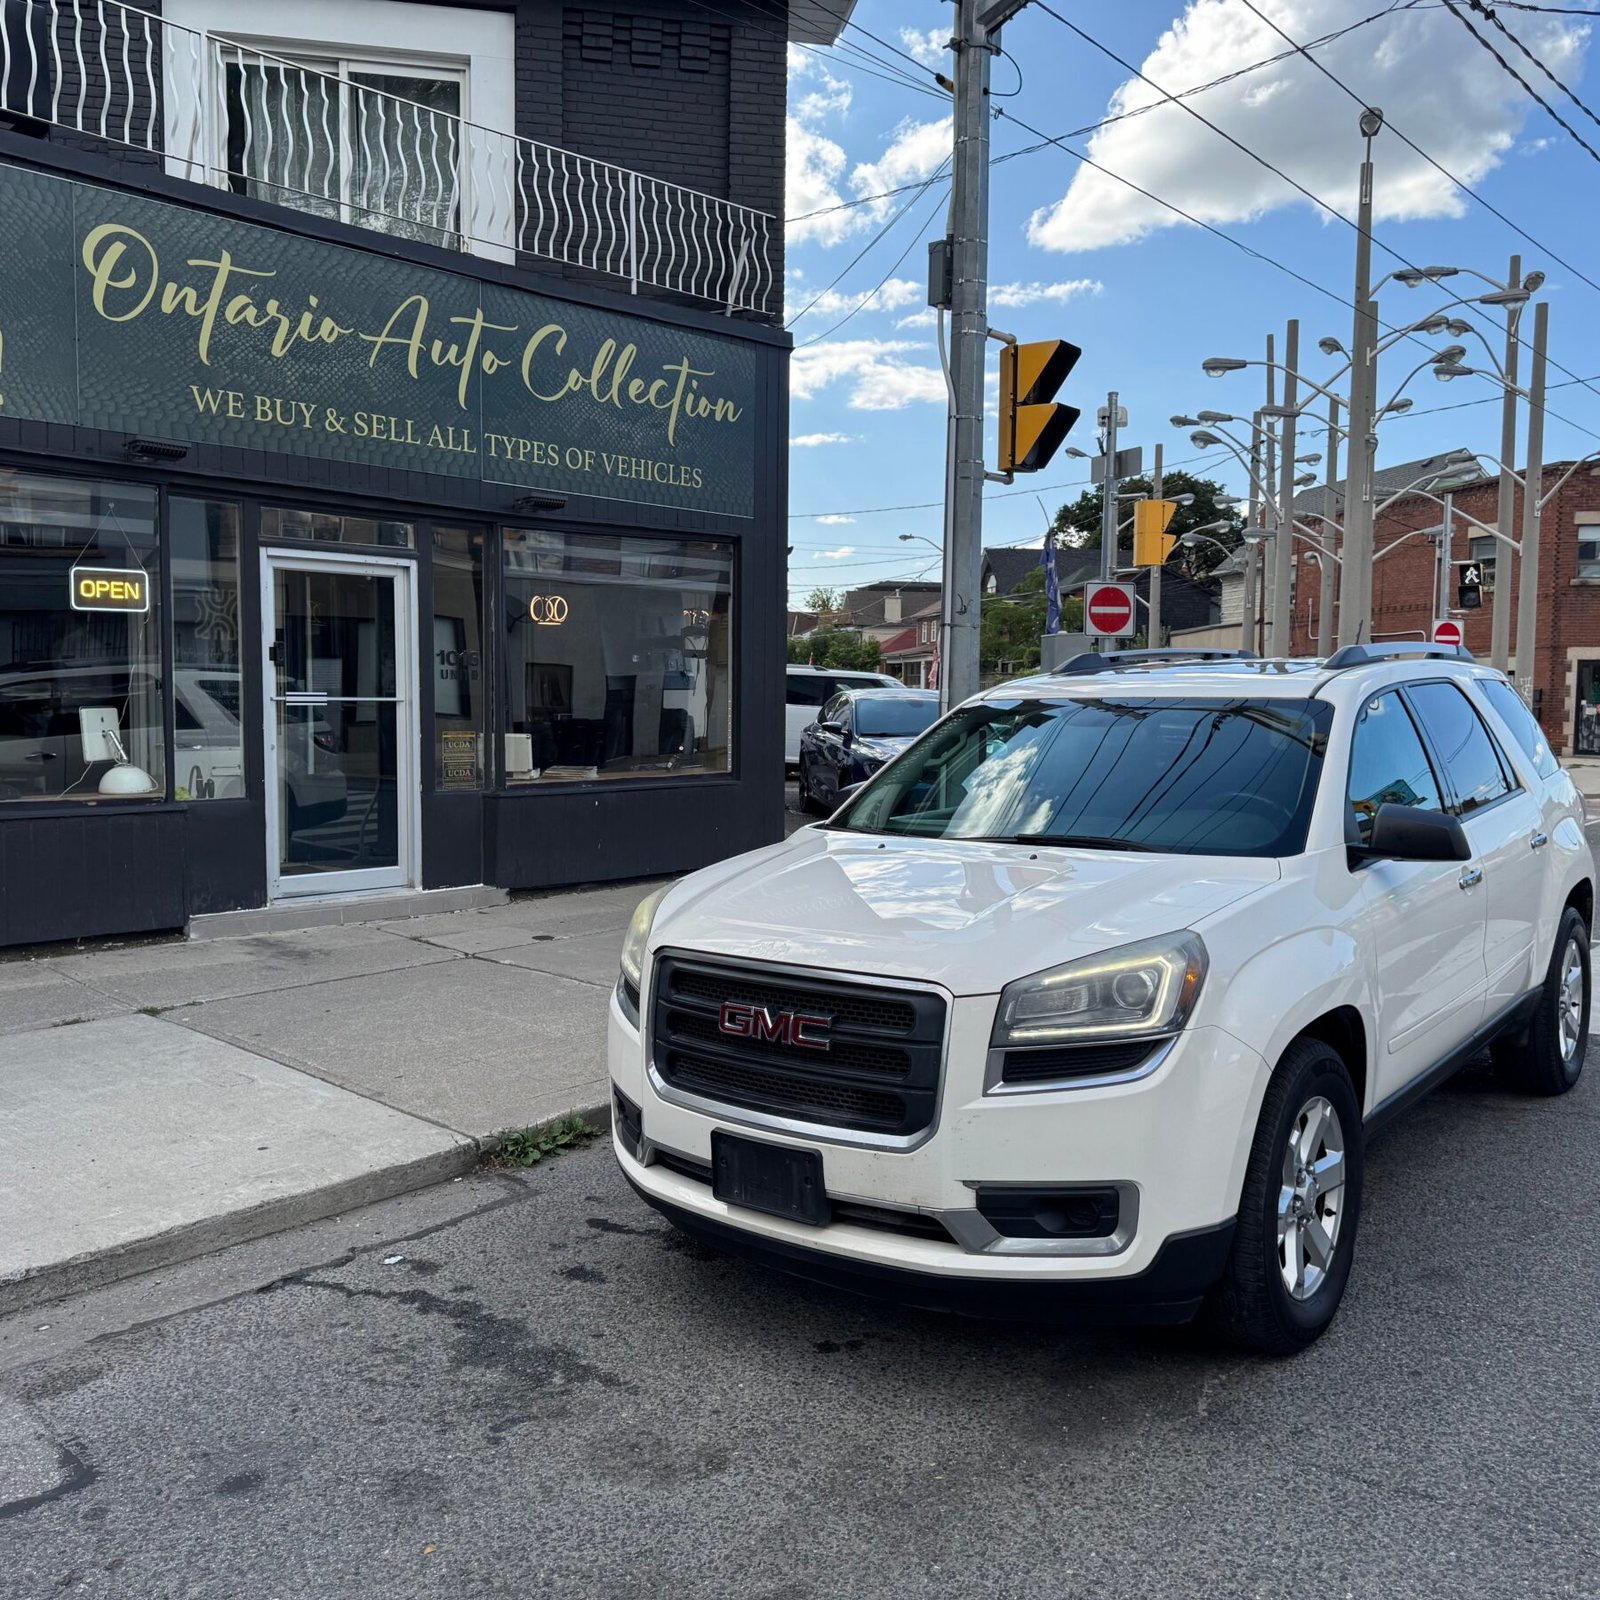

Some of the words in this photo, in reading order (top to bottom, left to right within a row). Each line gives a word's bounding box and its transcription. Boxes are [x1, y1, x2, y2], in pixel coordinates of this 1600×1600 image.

[82, 223, 354, 366] Ontario
[358, 294, 519, 410] Auto
[521, 323, 743, 447] Collection
[190, 385, 246, 418] WE
[255, 396, 318, 429] BUY
[325, 407, 348, 434] &
[354, 411, 421, 445] SELL
[426, 424, 477, 454] ALL
[485, 432, 560, 466] TYPES
[565, 447, 596, 472] OF
[600, 452, 703, 488] VEHICLES
[80, 579, 140, 600] OPEN
[448, 769, 471, 777] UCDA
[718, 1001, 832, 1051] GMC
